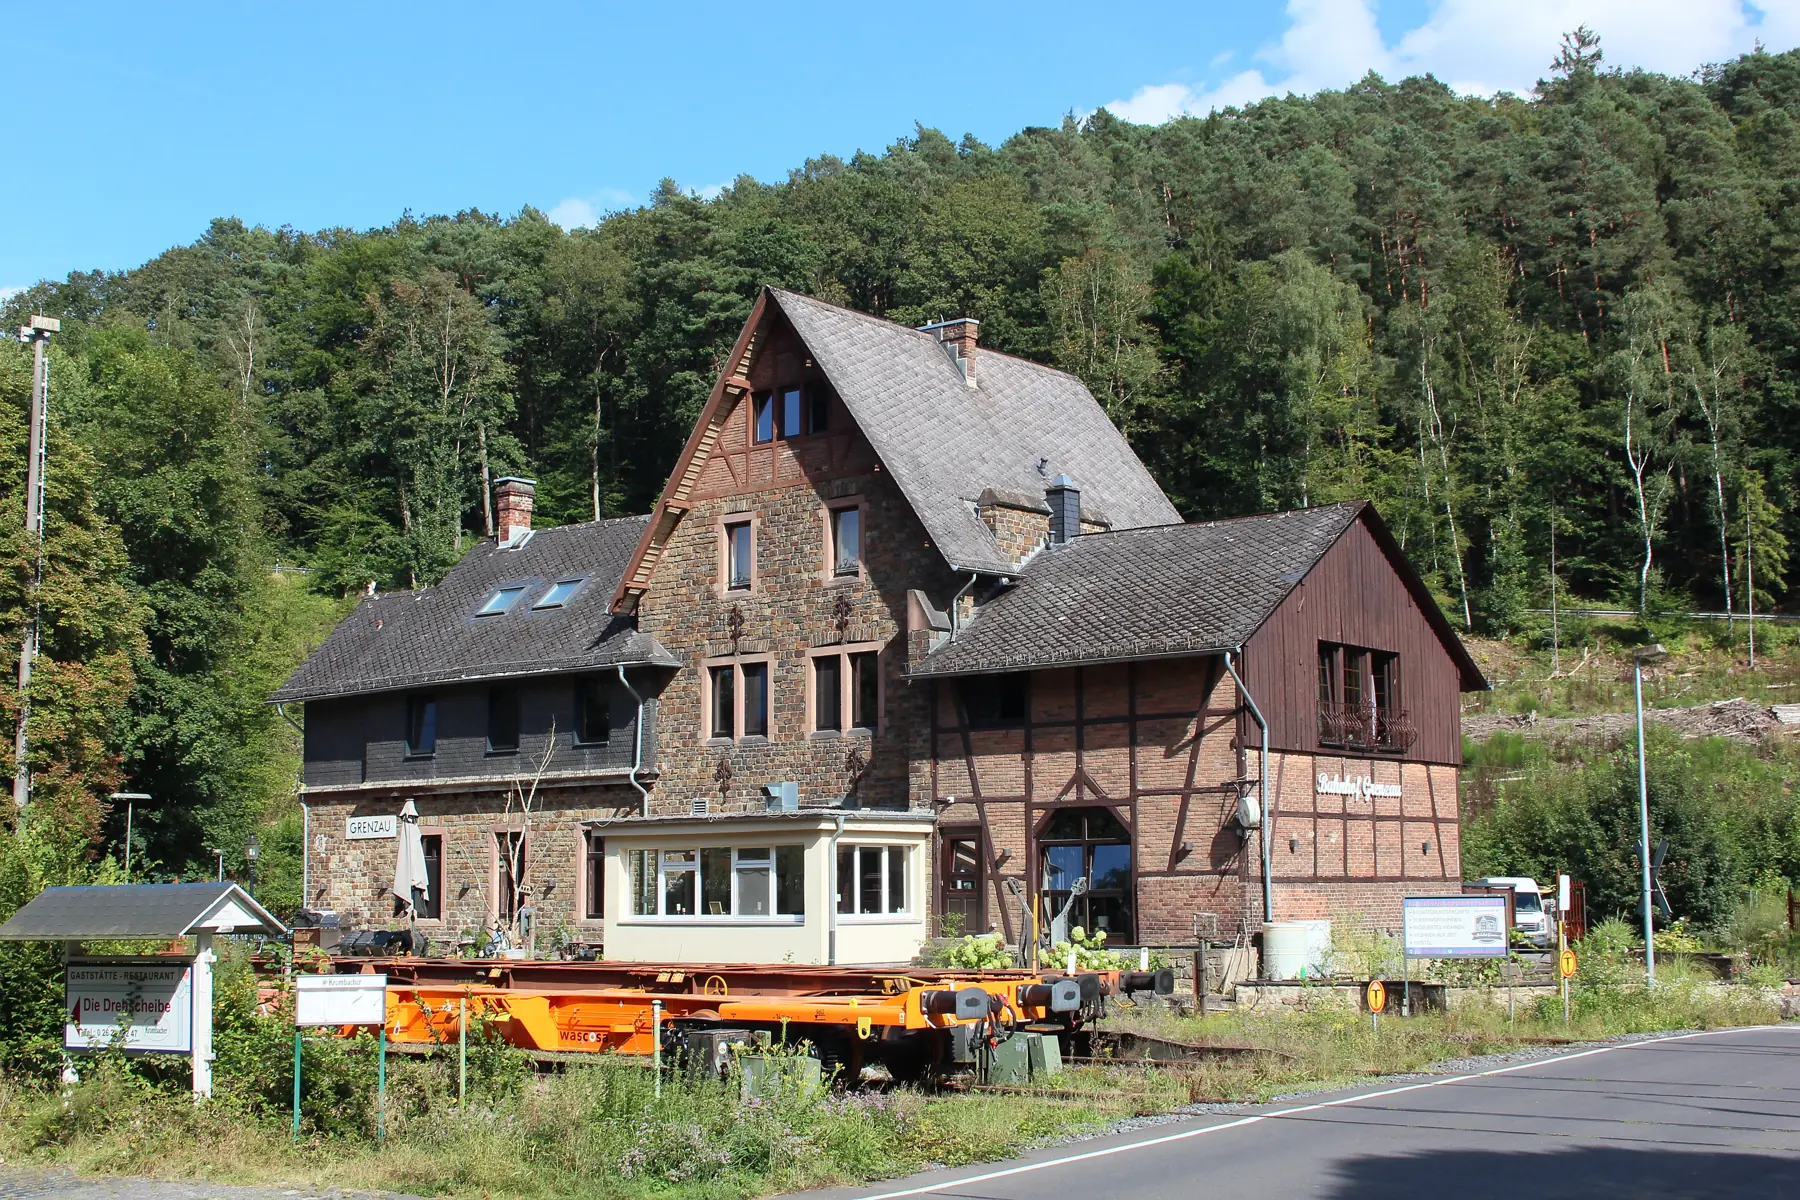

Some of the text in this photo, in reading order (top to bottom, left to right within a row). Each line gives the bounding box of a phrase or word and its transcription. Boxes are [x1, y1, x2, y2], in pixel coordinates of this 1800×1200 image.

[349, 820, 391, 834] GRENZAU
[70, 970, 118, 980] GASTSTÄTTE
[124, 971, 175, 981] RESTAURANT
[329, 978, 362, 986] Krombacher
[83, 998, 100, 1012] Die
[560, 1031, 608, 1043] wascosa
